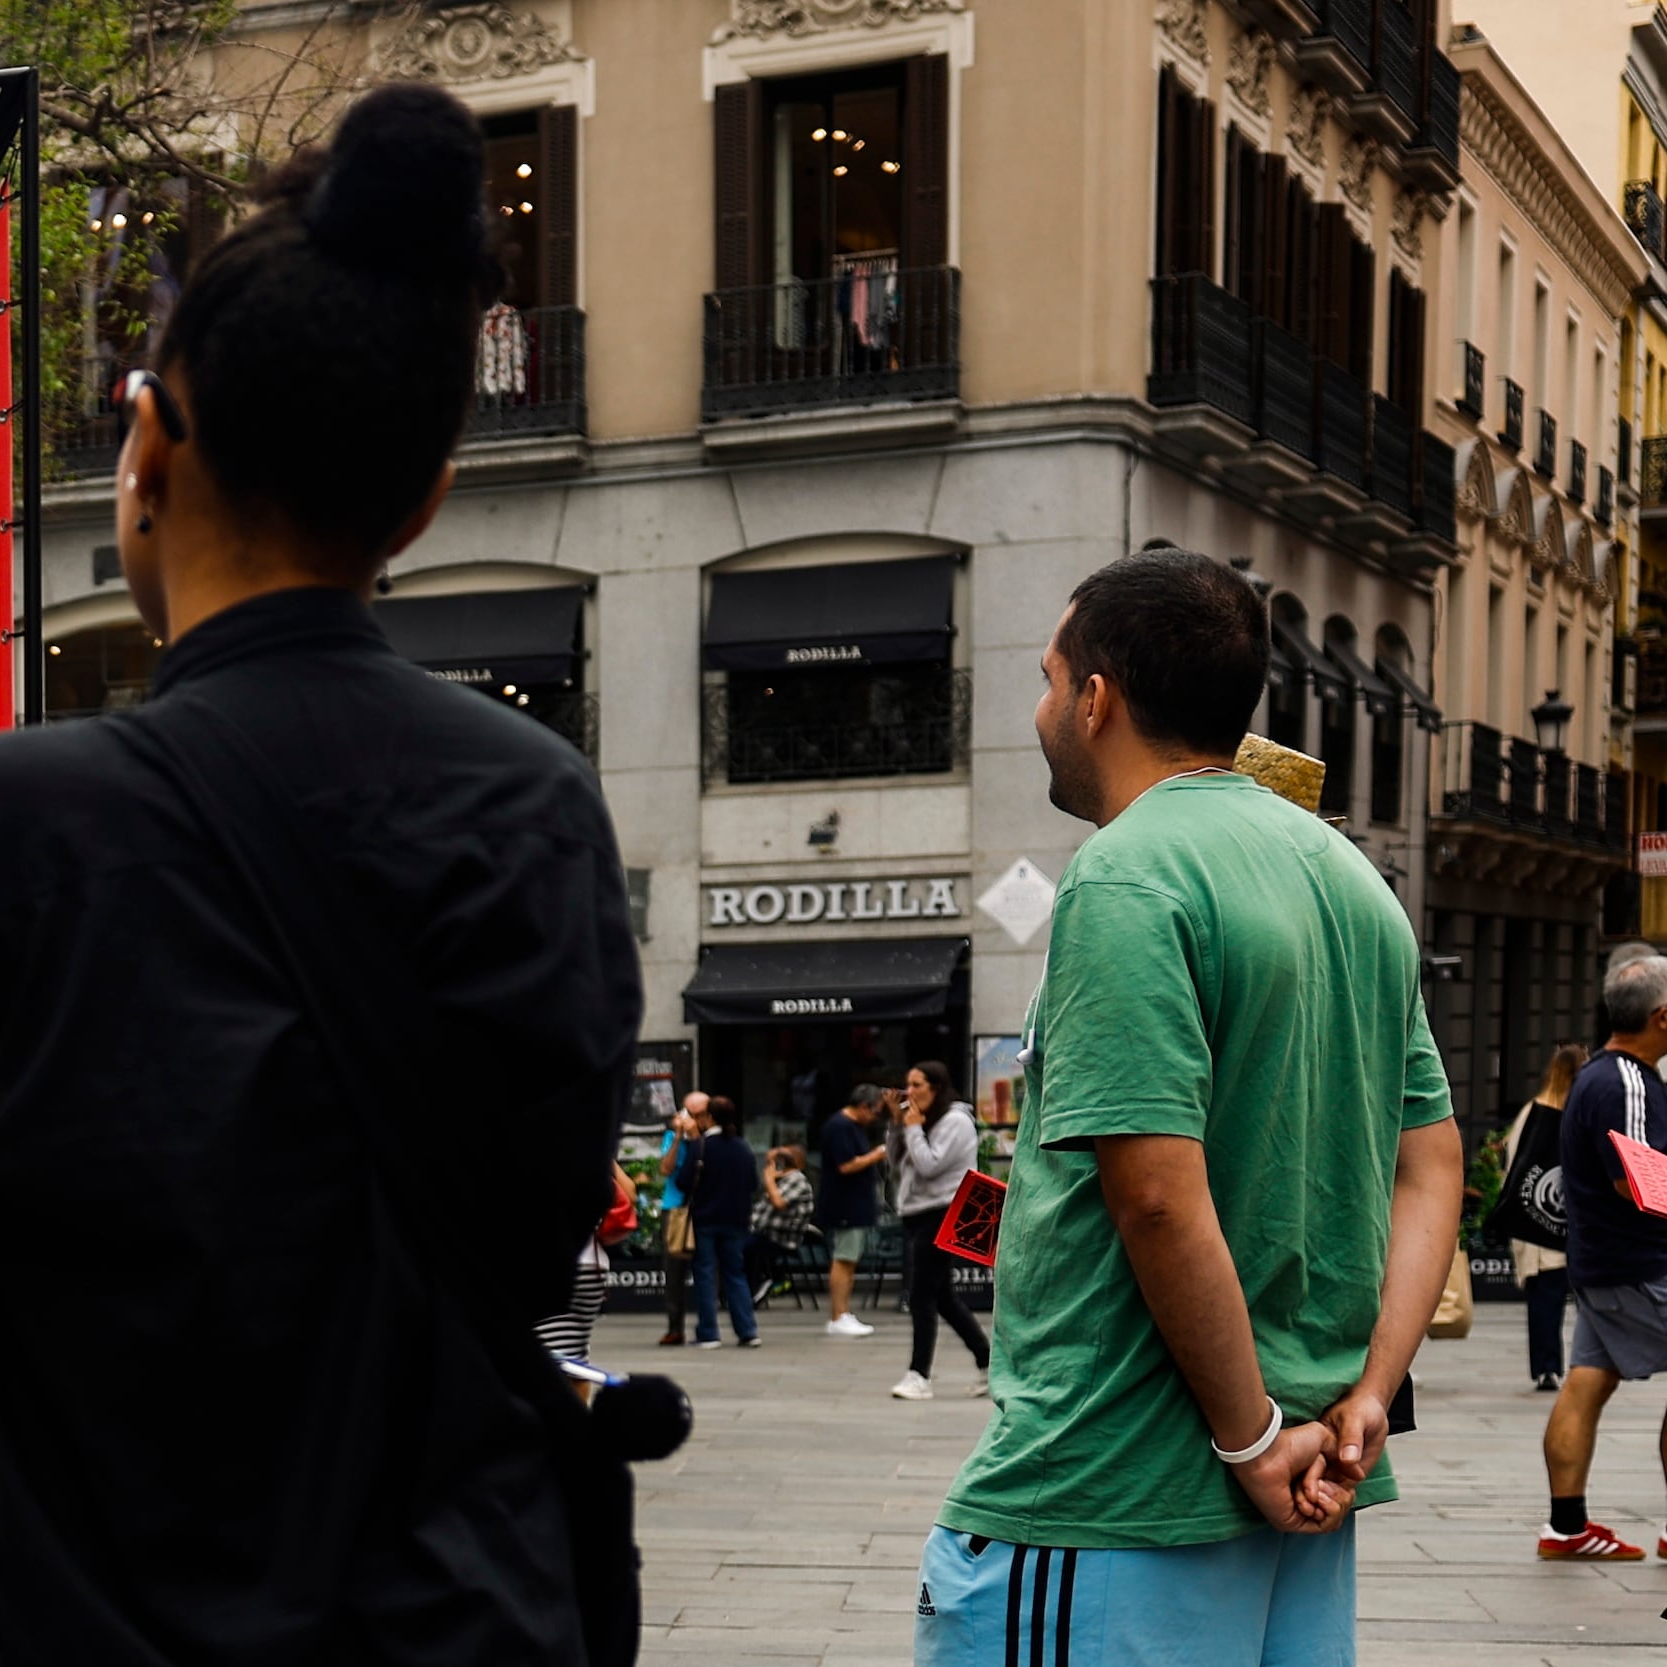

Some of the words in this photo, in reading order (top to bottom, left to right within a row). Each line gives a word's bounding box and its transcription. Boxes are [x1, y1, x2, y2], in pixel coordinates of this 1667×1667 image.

[786, 645, 862, 663] RODILLA
[709, 877, 961, 926] RODILLA
[771, 997, 853, 1015] RODILLA
